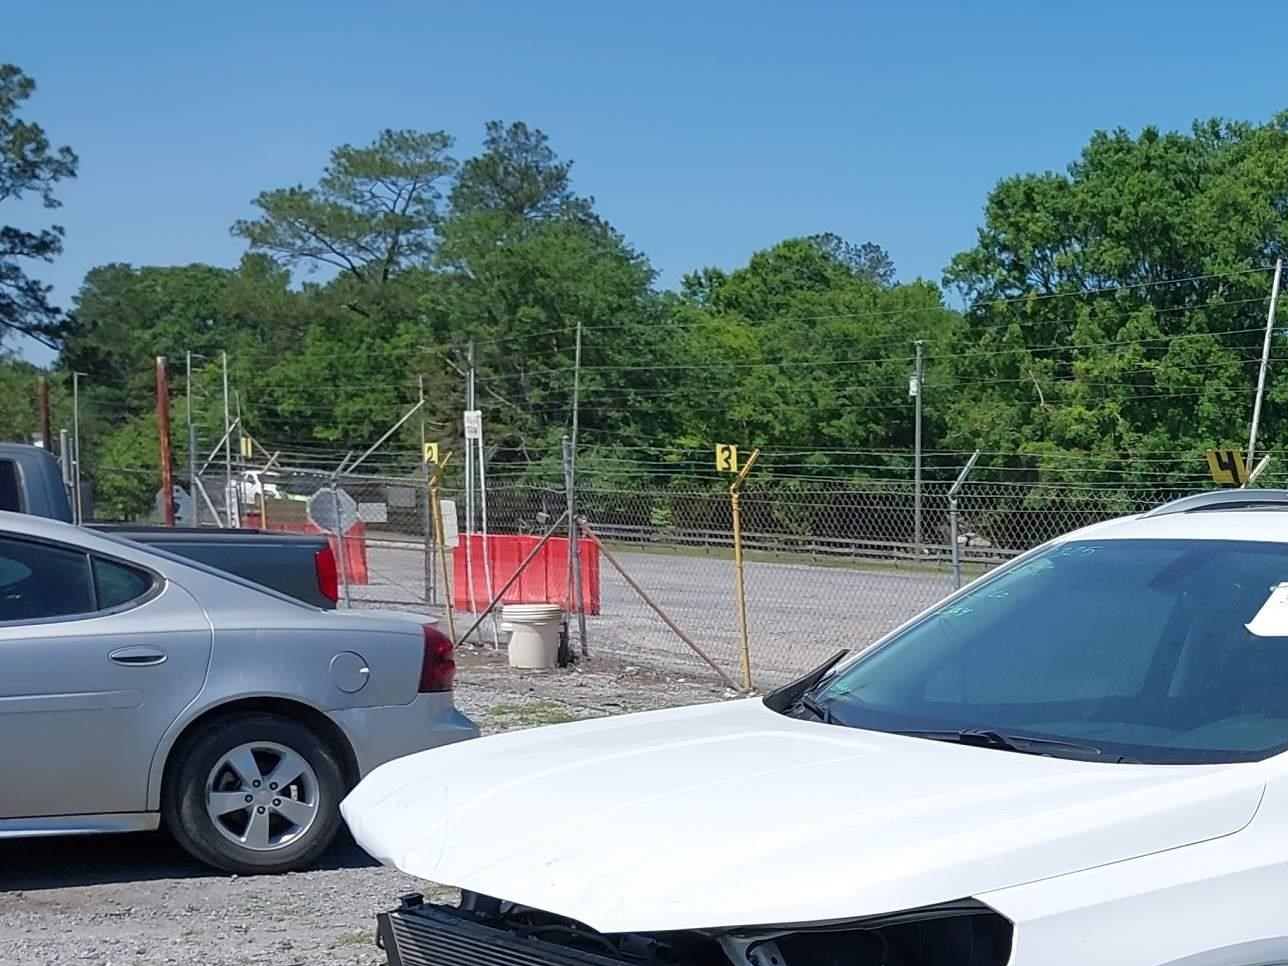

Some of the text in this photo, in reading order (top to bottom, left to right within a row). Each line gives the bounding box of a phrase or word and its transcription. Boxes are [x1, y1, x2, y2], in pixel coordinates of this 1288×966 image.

[426, 446, 435, 464] 2
[720, 446, 732, 470] 3
[1215, 451, 1241, 488] 4
